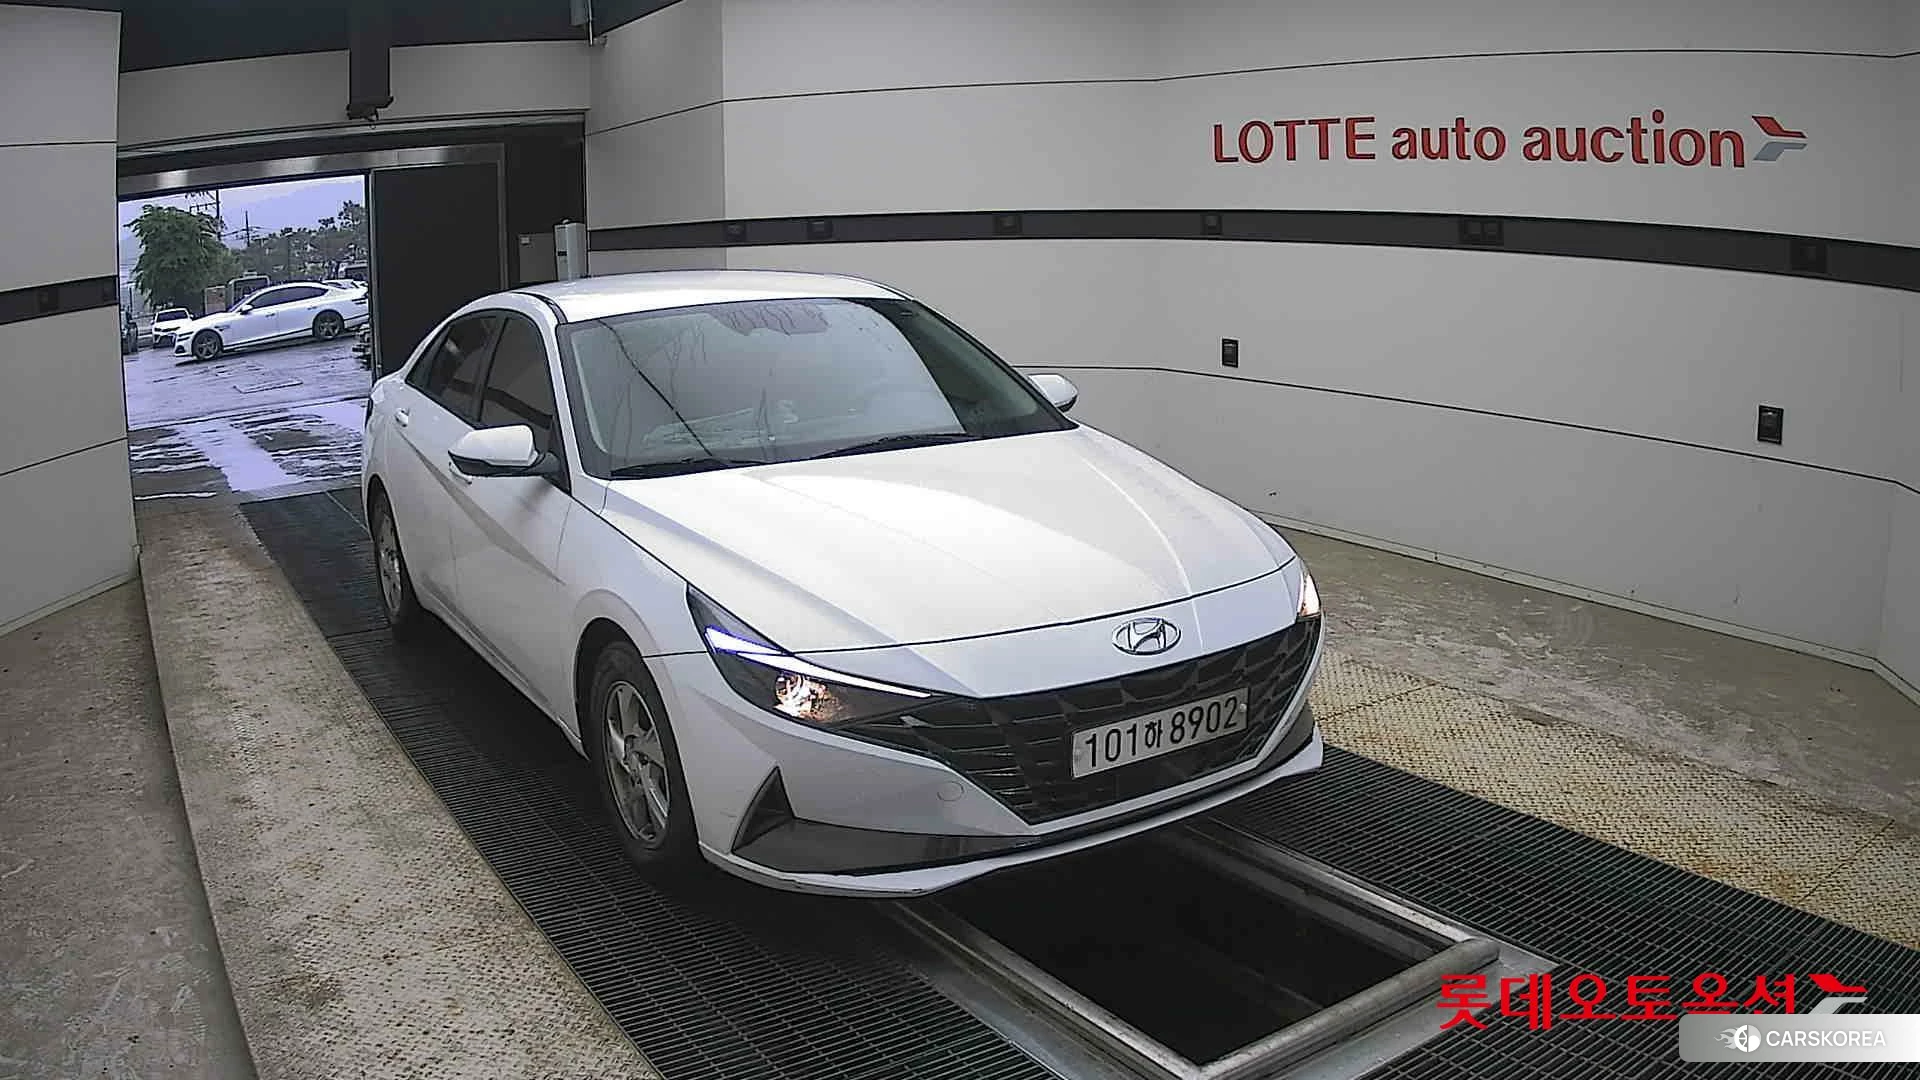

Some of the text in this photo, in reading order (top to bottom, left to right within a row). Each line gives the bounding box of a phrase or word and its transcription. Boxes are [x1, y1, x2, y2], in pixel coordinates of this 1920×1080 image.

[1212, 109, 1746, 168] LOTTE auto auction
